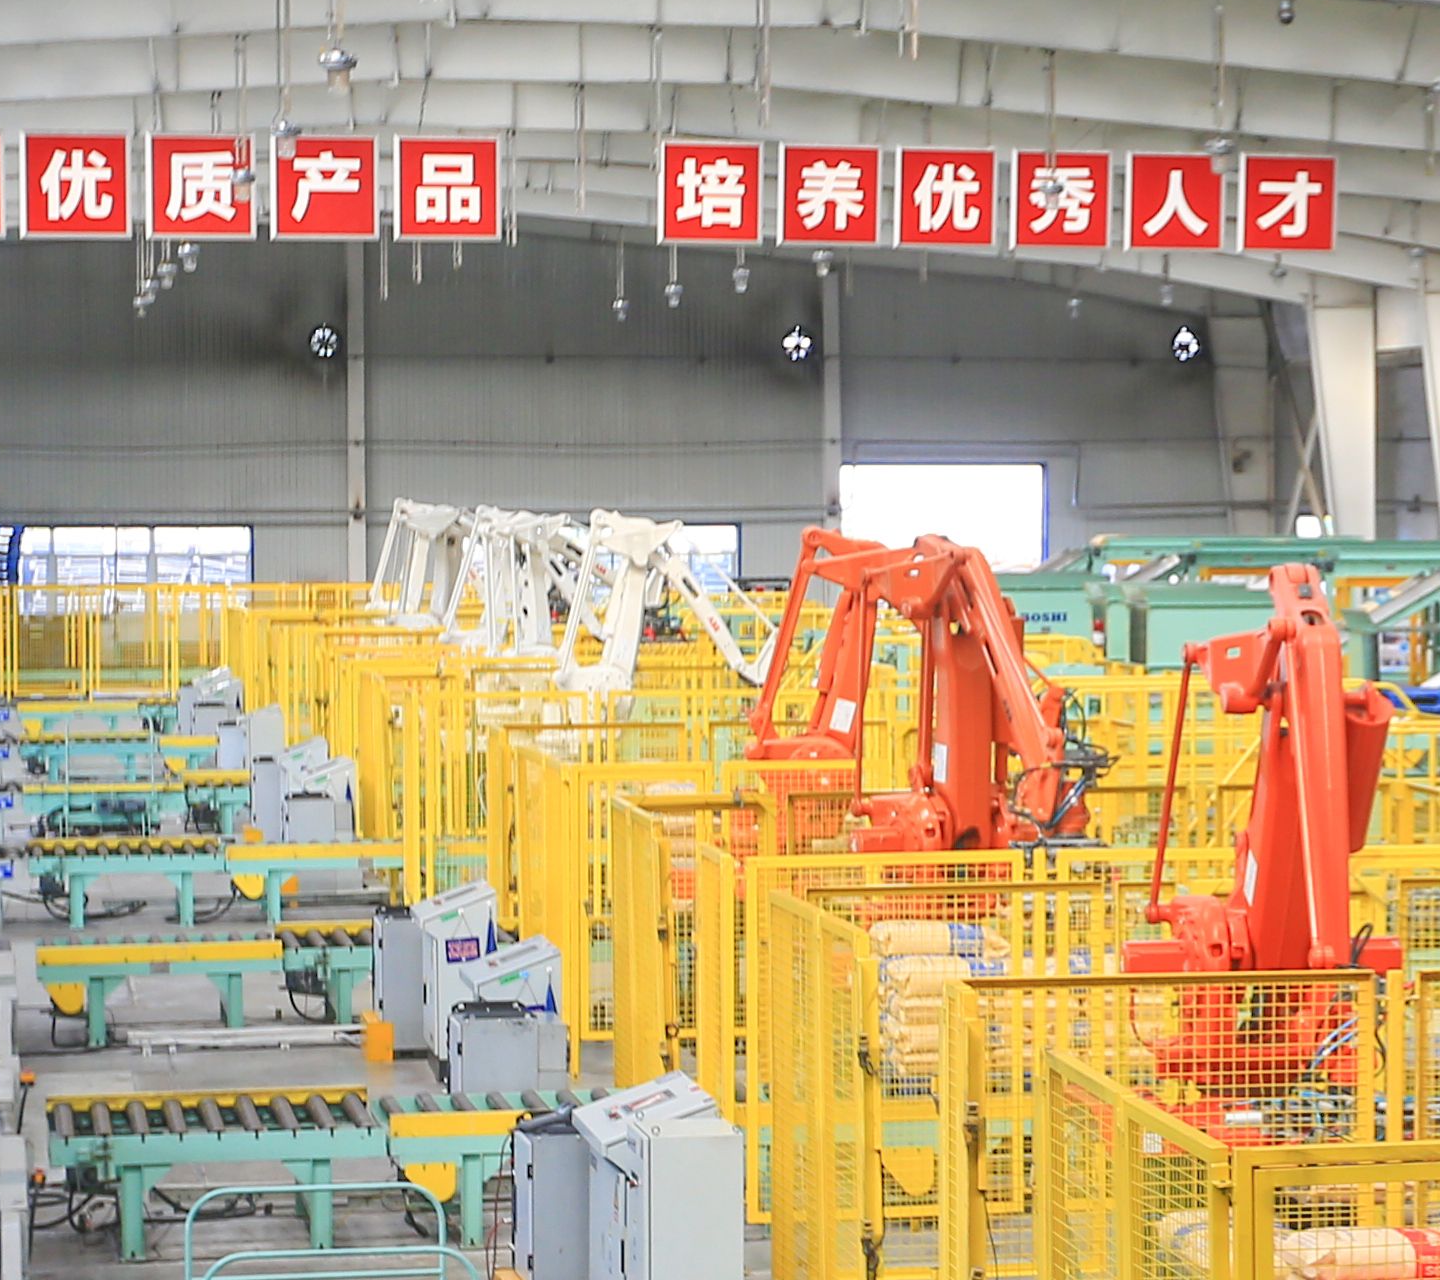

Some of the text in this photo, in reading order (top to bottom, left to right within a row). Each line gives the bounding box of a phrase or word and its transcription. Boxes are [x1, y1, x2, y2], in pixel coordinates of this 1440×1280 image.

[675, 158, 1322, 237] 培养优秀人才
